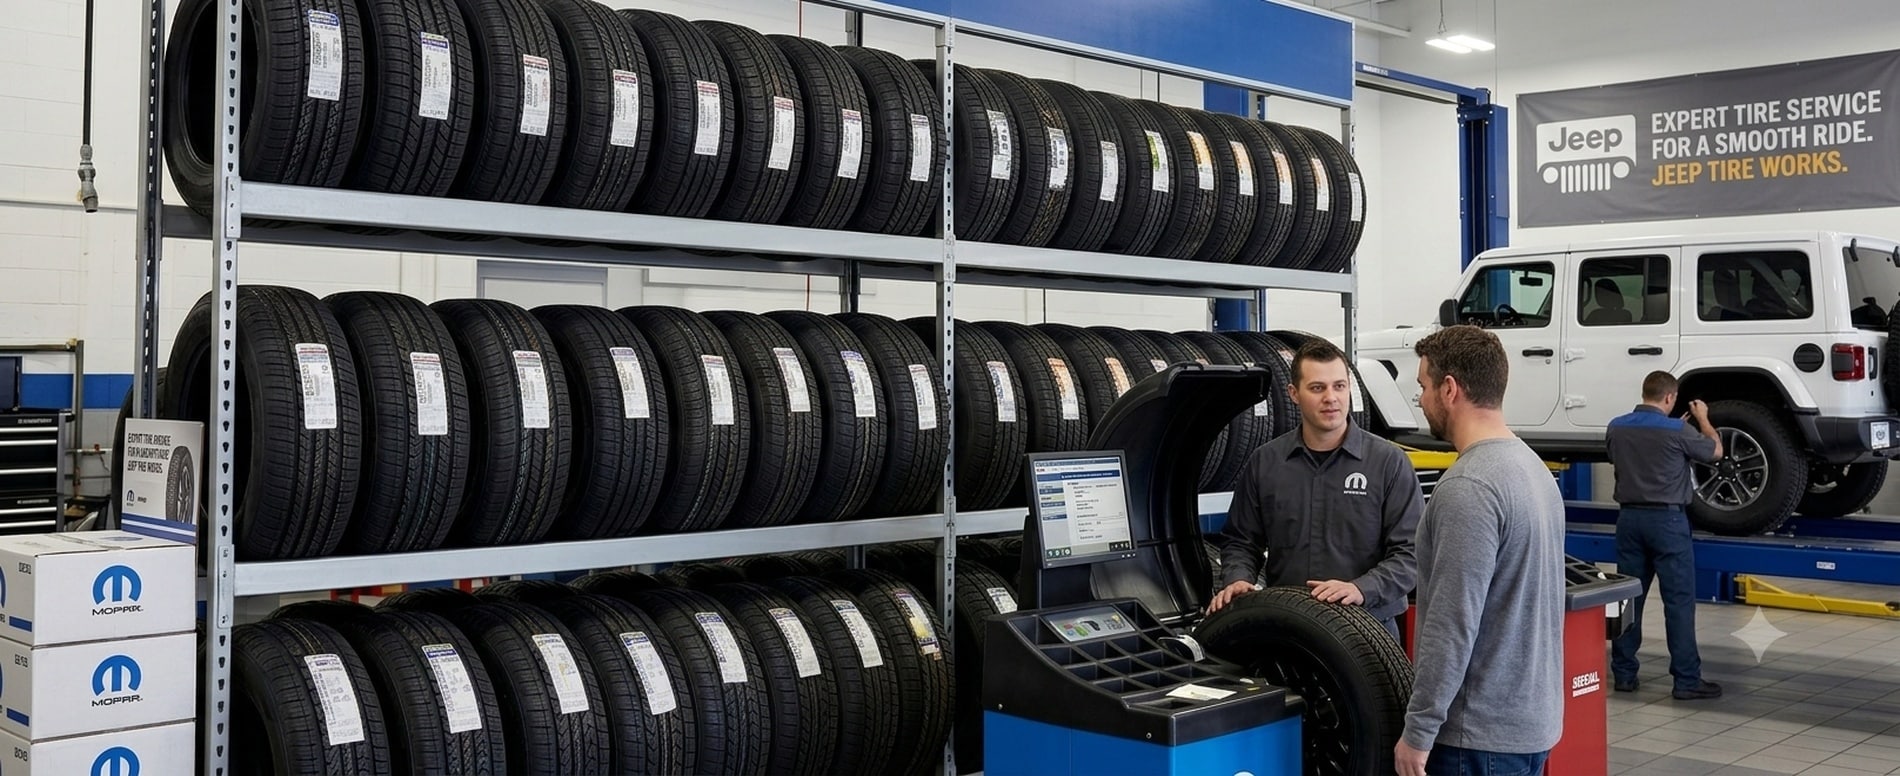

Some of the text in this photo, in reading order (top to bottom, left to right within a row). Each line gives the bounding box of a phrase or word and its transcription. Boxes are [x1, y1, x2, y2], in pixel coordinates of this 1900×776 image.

[1652, 89, 1882, 134] EXPERT TIRE SERVICE
[1548, 127, 1623, 153] Jeep
[1652, 119, 1873, 160] FOR A SMOOTH RIDE.
[1652, 150, 1849, 187] JEEP TIRE WORKS.
